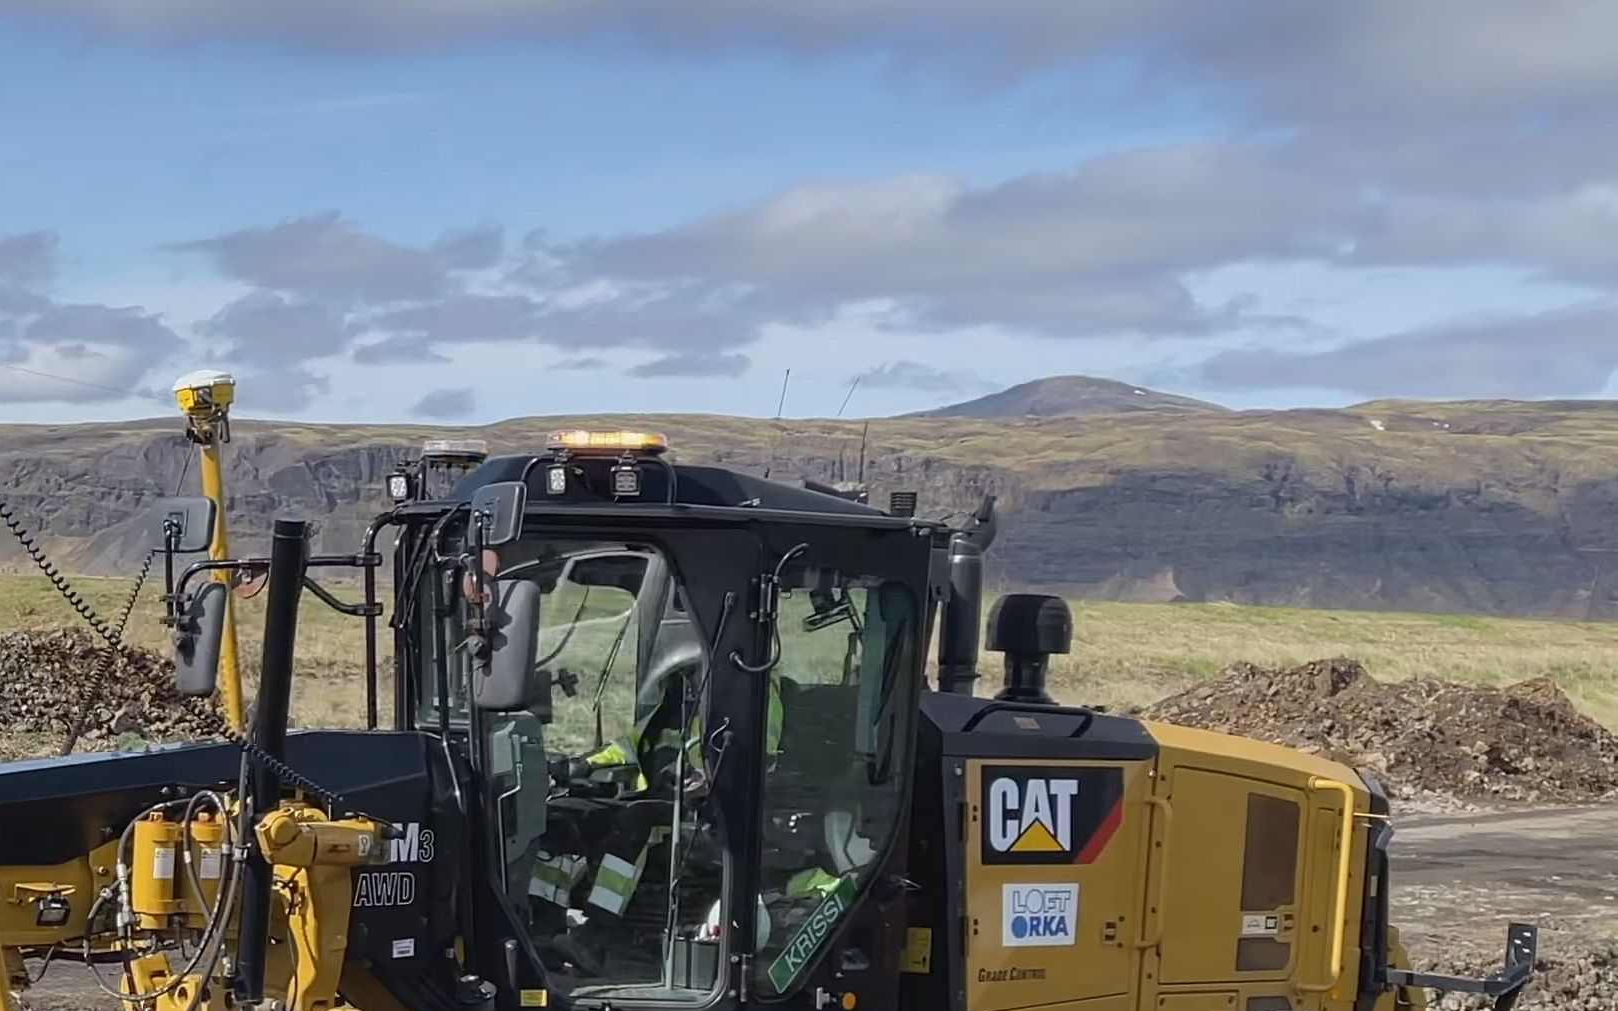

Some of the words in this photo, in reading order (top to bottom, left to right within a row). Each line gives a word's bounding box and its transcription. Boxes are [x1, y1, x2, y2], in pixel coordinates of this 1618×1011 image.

[989, 777, 1078, 852] CAT
[353, 872, 415, 906] AWD
[1012, 889, 1072, 914] LOFT
[784, 894, 844, 972] KRISSI
[1011, 915, 1069, 939] ORKA
